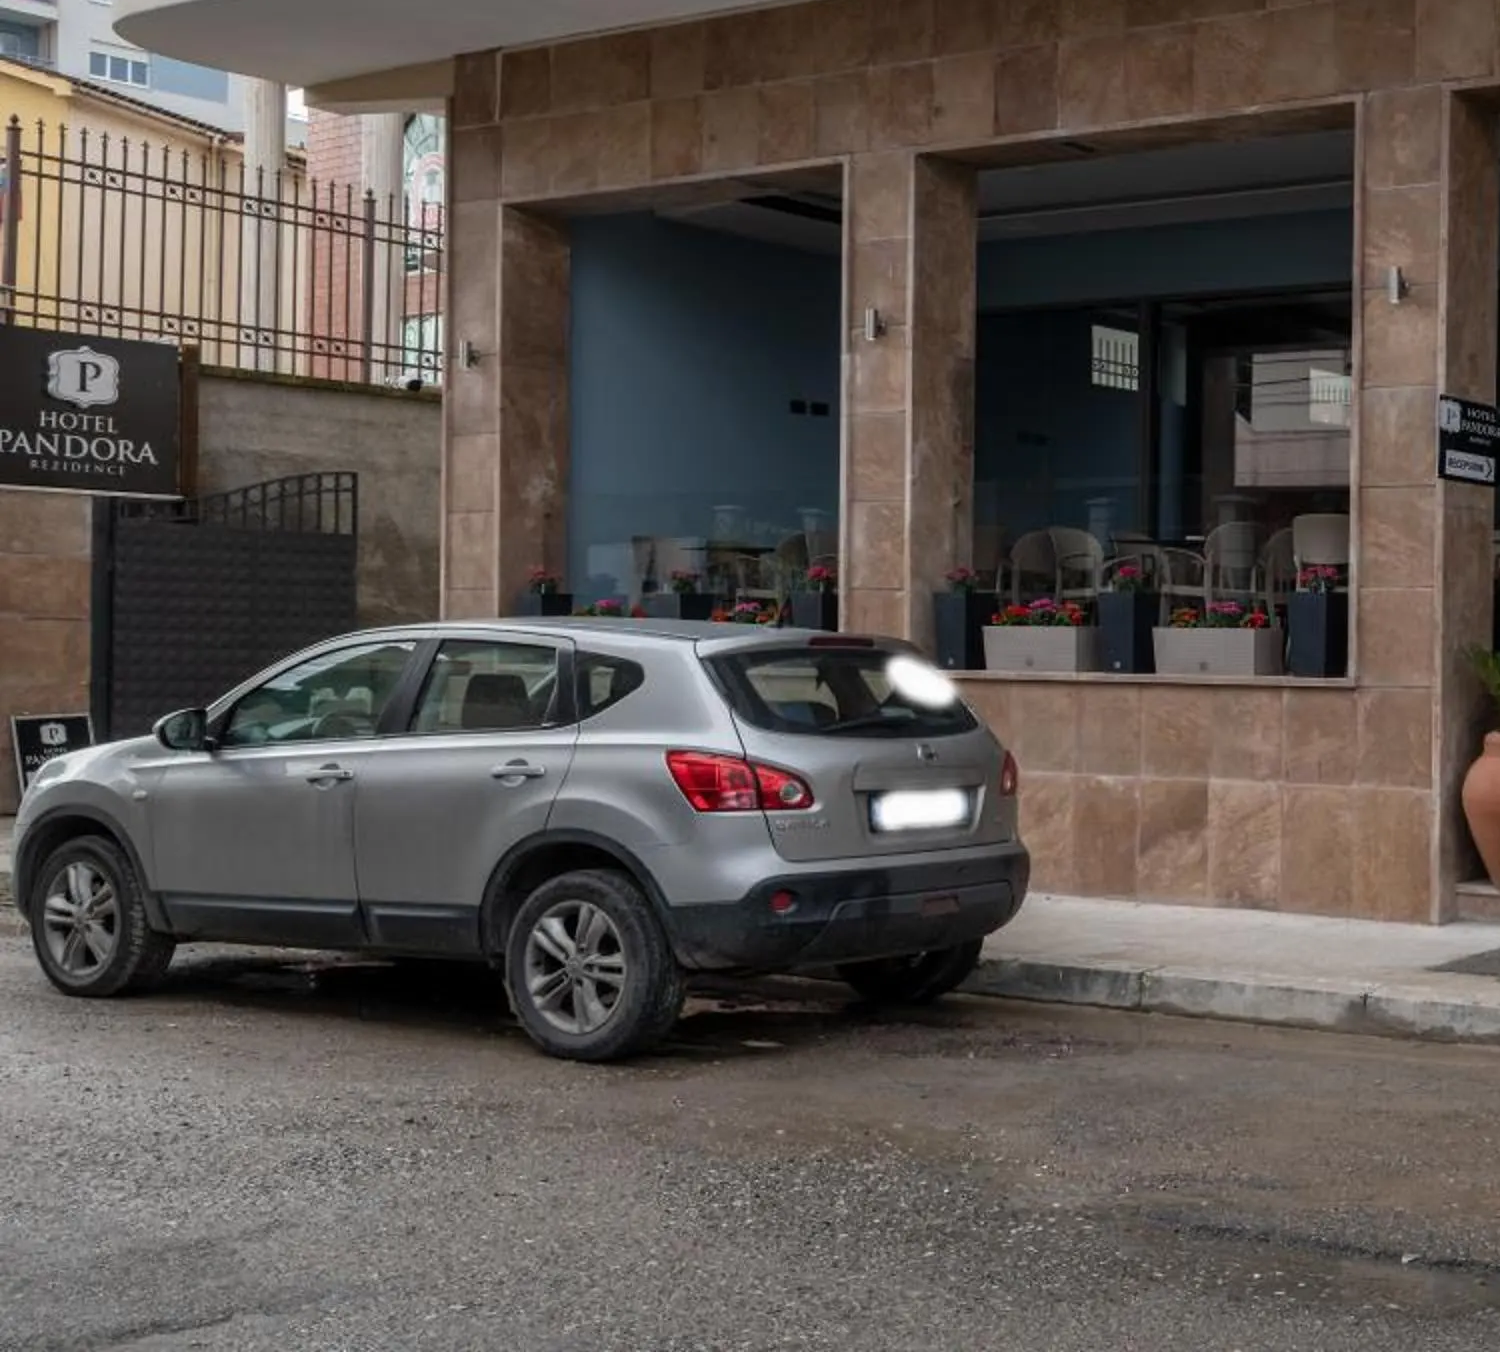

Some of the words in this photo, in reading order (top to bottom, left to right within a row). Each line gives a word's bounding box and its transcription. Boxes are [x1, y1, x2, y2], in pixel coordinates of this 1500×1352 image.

[78, 360, 102, 392] P
[40, 410, 119, 434] HOTEL
[0, 428, 159, 465] PANDORA
